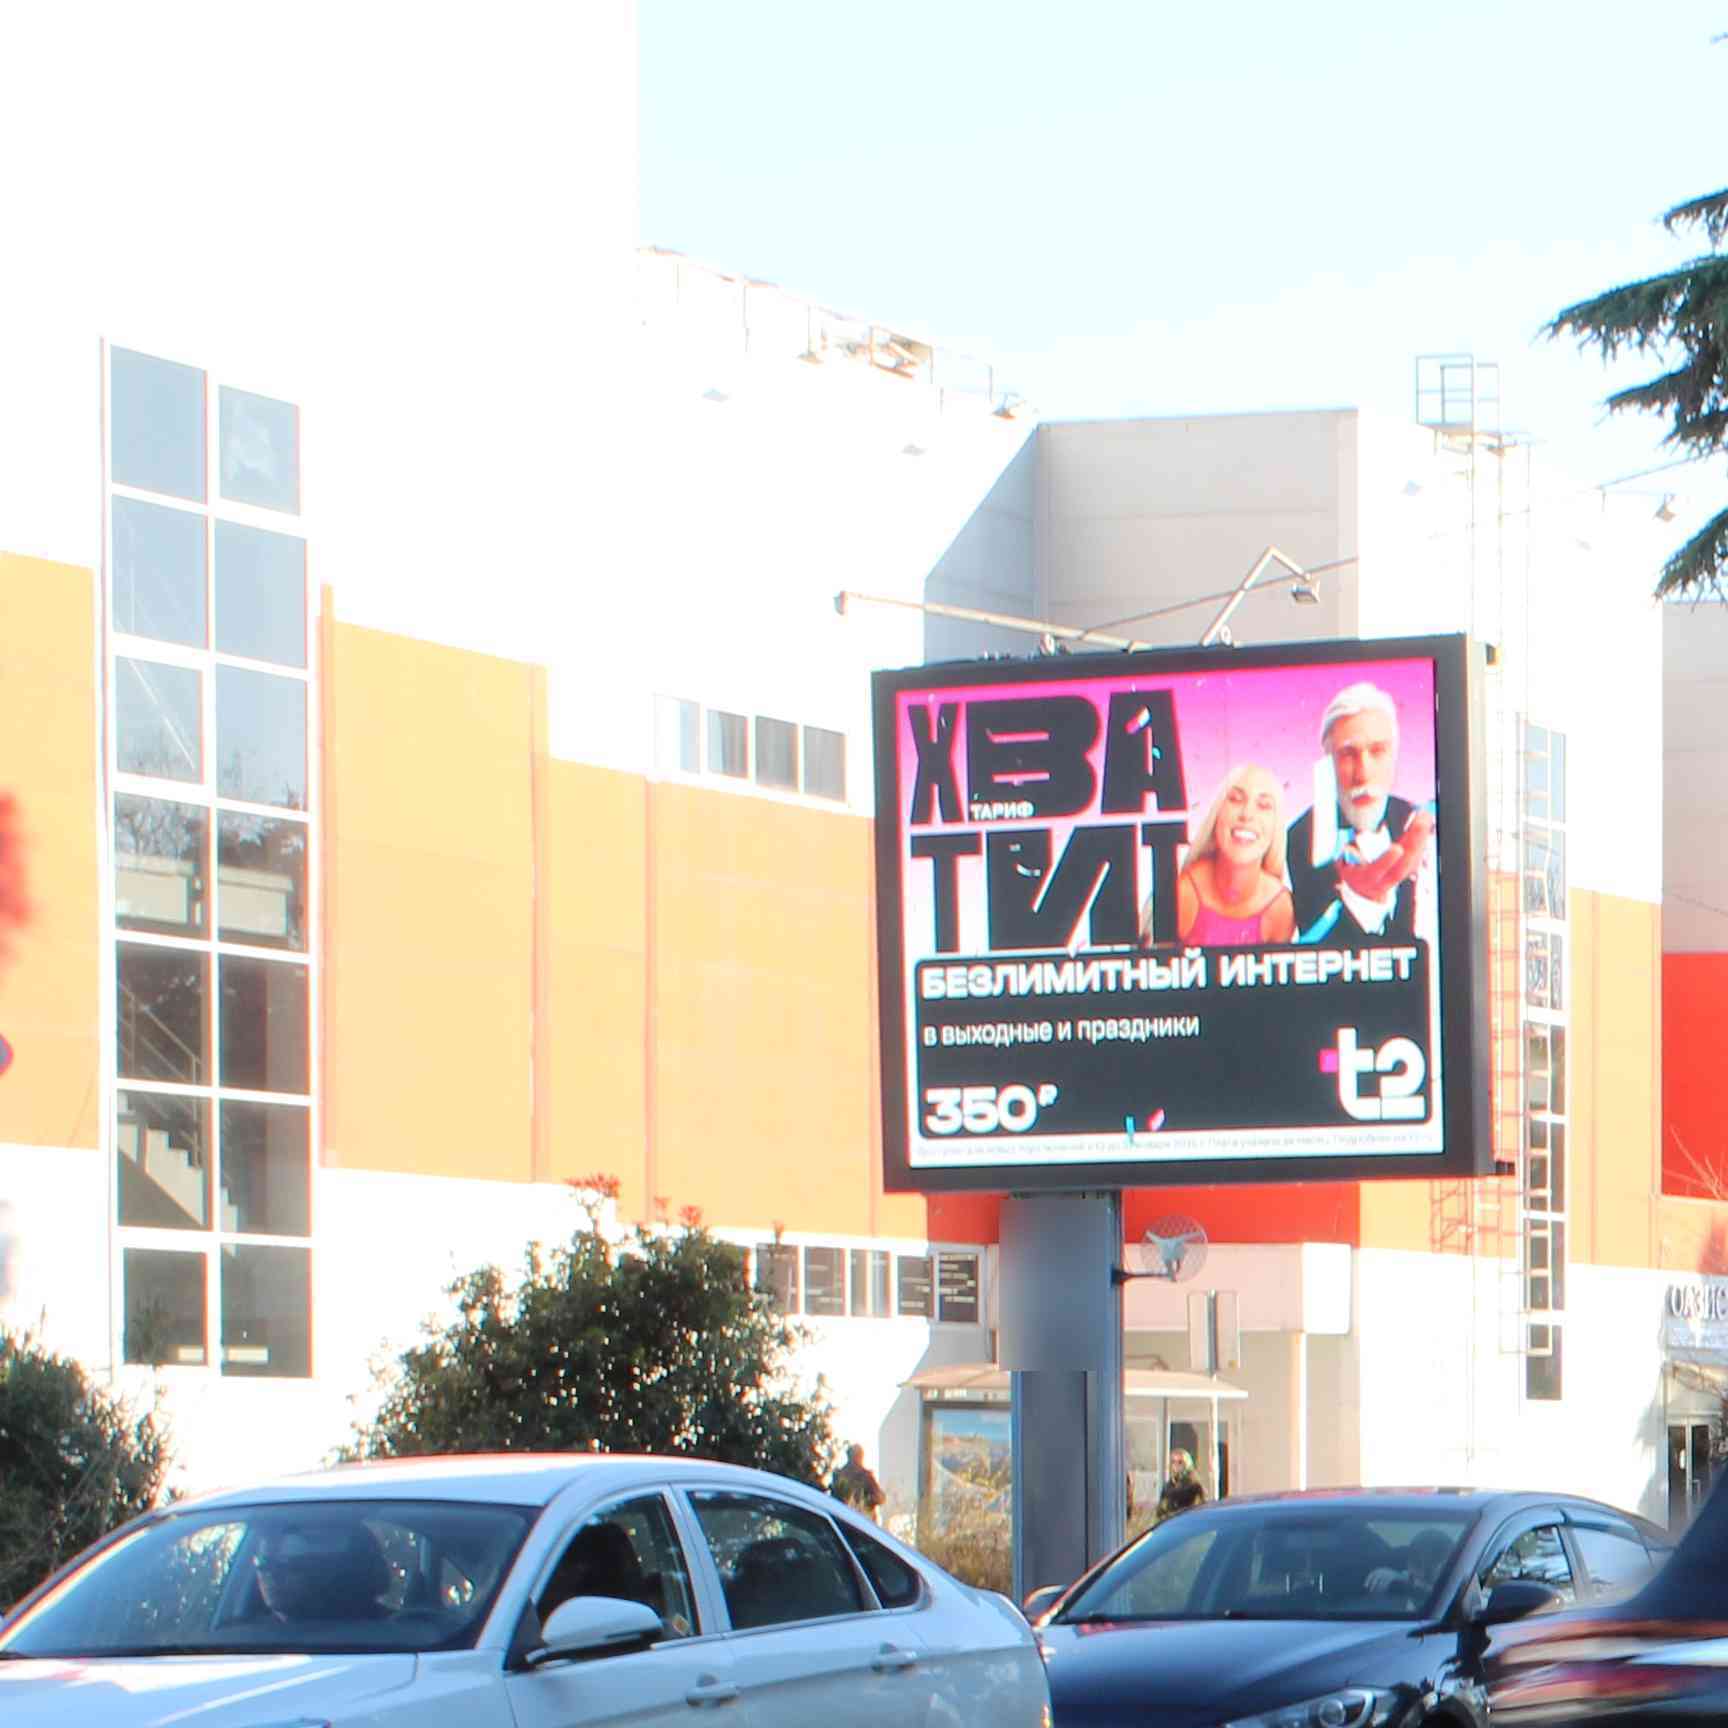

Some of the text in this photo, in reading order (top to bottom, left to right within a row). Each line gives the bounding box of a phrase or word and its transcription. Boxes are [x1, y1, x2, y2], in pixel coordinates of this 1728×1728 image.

[970, 801, 1034, 821] ТАРИФ
[922, 947, 1418, 1000] БЕЗЛИМИТНЫЙ ИНТЕРНЕТ
[924, 1015, 1201, 1046] в выходные и праздники
[1319, 1027, 1427, 1121] t2
